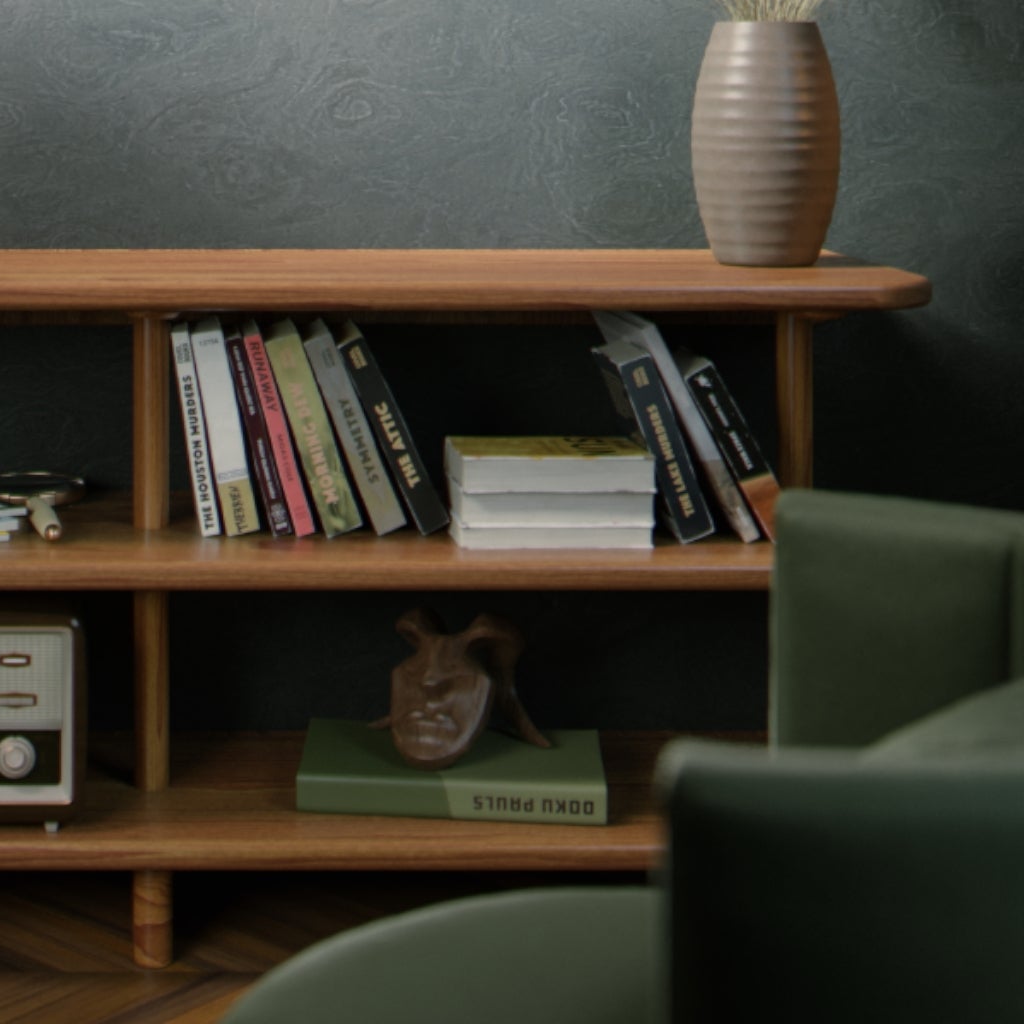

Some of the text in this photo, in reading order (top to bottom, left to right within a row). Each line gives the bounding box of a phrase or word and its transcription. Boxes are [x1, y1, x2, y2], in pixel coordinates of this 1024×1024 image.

[249, 341, 278, 412] RUNAWAY
[182, 375, 215, 530] THE HOUSTON MURDERS
[303, 418, 340, 505] MORNING
[338, 398, 378, 484] SYMMETRY
[374, 401, 421, 489] THE ATTIC
[646, 403, 694, 518] THE LAKE MURDERS
[473, 794, 534, 813] PAULS
